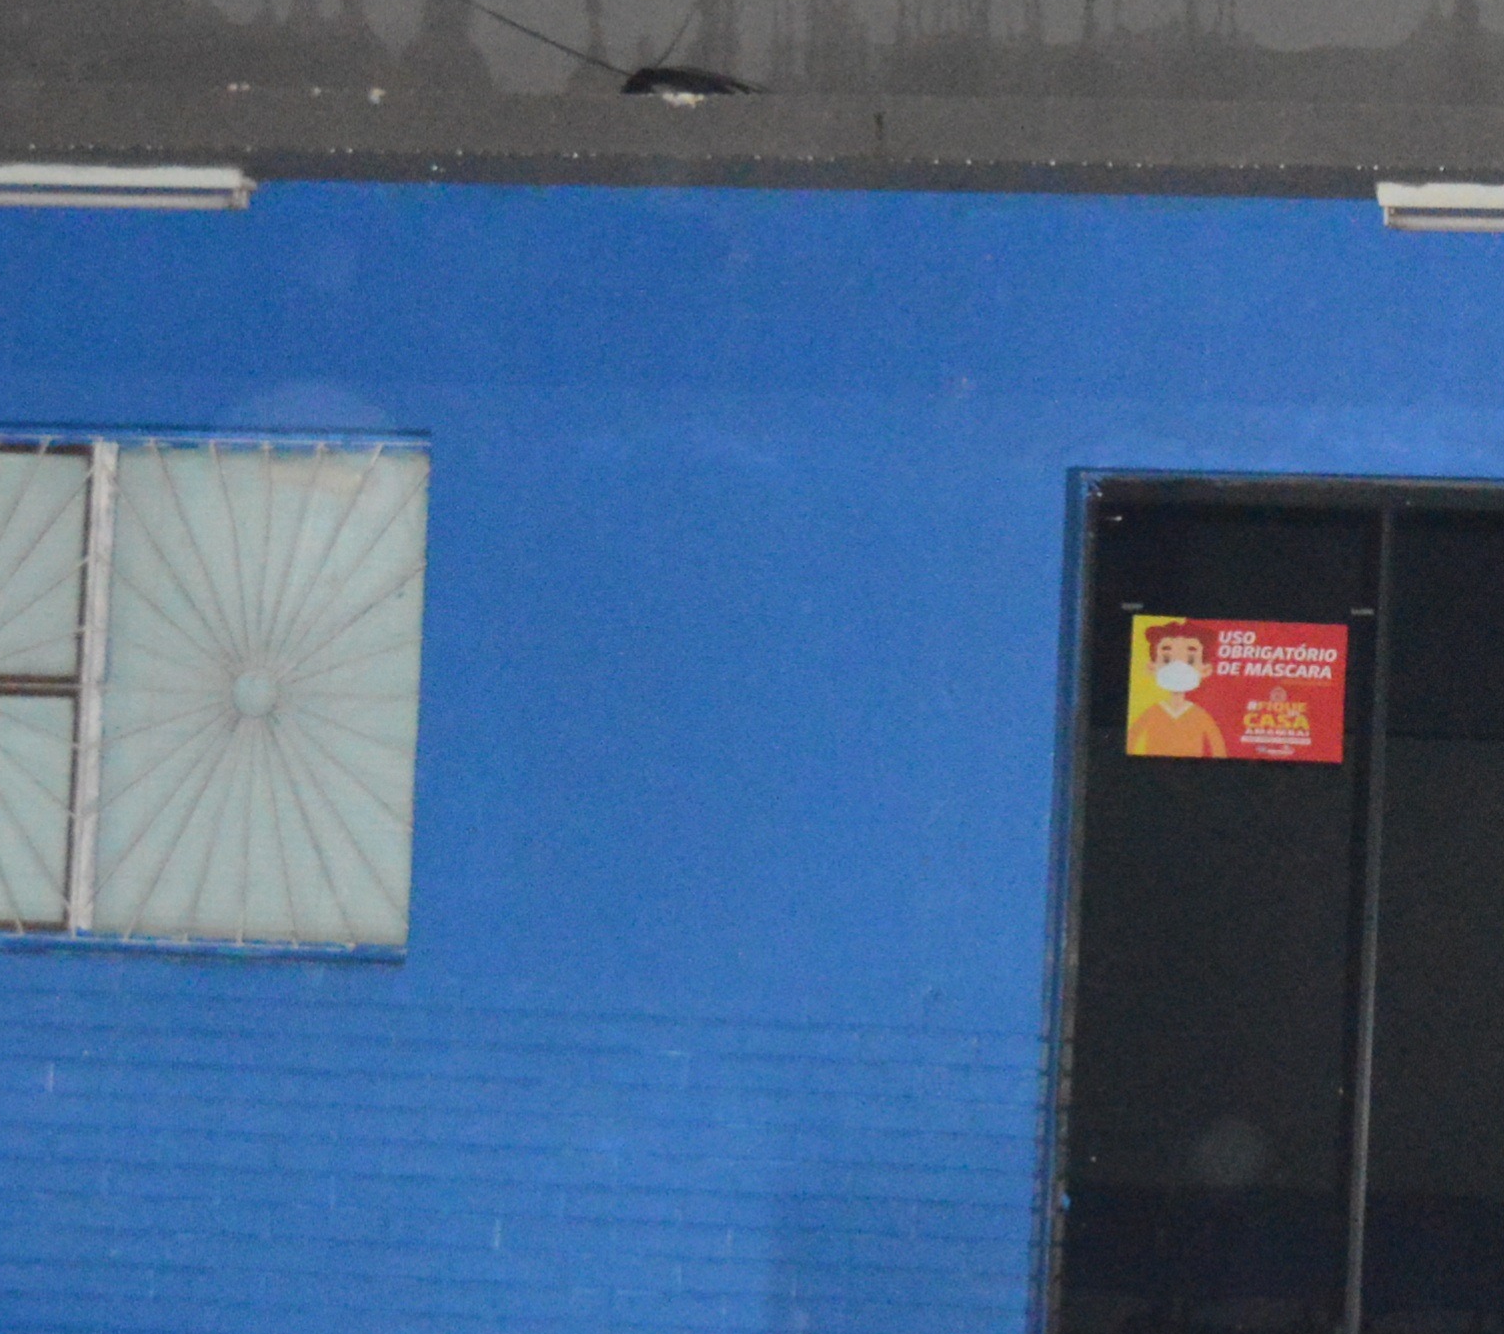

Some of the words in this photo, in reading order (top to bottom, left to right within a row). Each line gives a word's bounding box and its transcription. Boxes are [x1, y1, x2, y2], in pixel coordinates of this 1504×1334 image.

[1218, 631, 1256, 644] USO
[1218, 643, 1338, 663] OBRIGATÓRIO
[1217, 661, 1241, 676] DE
[1244, 660, 1333, 680] MÁSCARA
[1243, 712, 1310, 730] CASA
